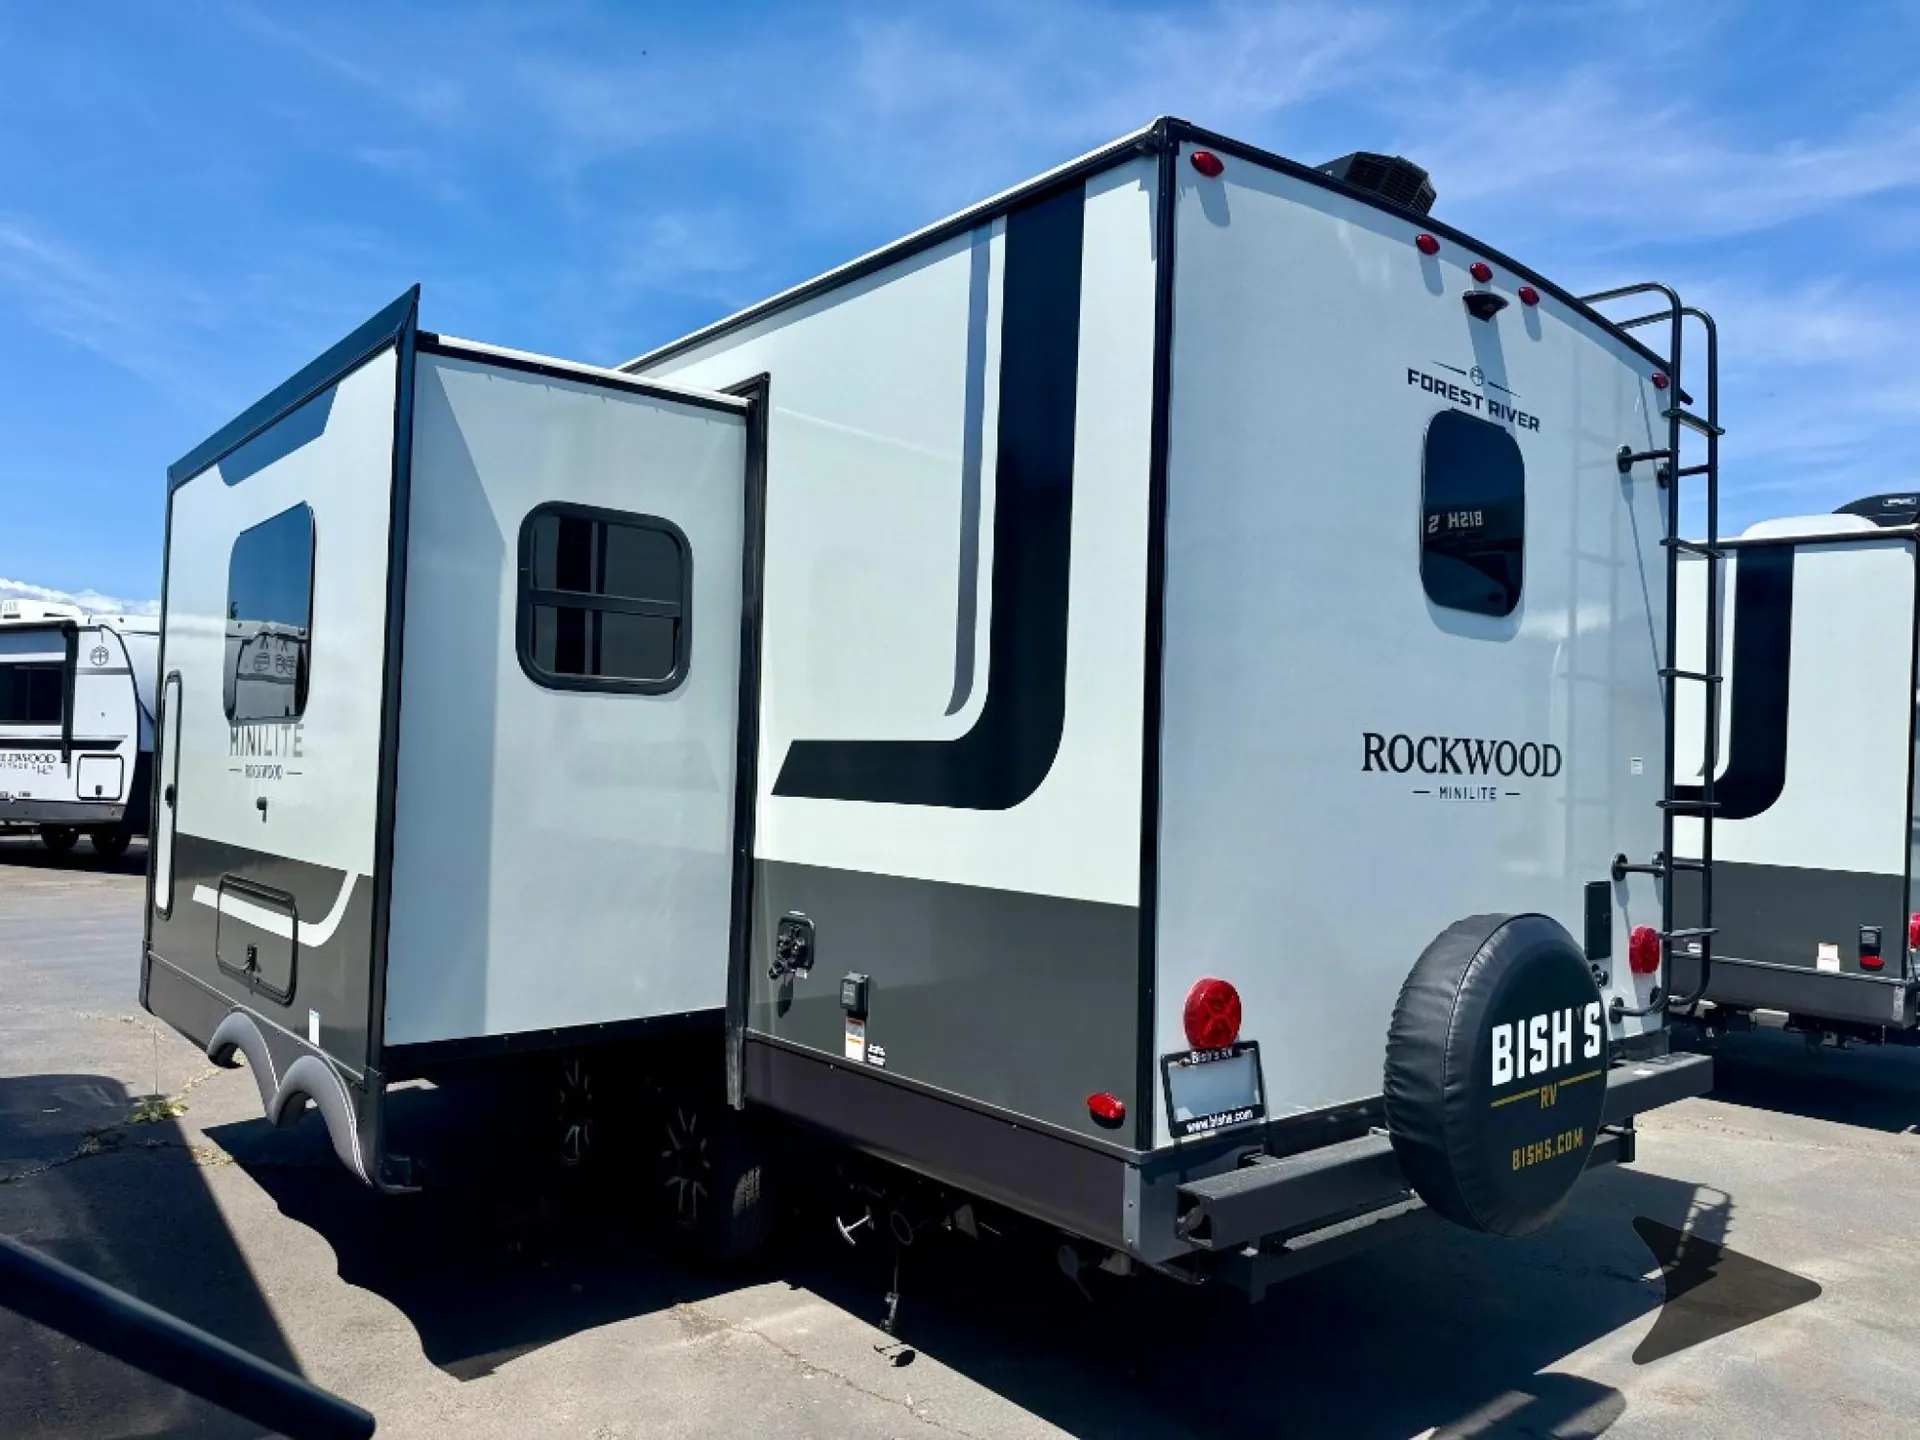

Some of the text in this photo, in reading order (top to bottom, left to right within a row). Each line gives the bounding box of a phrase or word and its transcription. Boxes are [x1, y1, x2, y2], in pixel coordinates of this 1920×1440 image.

[1407, 368, 1541, 432] FOREST RIVER
[229, 724, 304, 757] MINILITE
[1362, 732, 1562, 777] ROCKWOOD
[1439, 786, 1498, 800] MINILITE
[1540, 1084, 1558, 1109] RV
[1512, 1127, 1584, 1171] BISHS.COM
